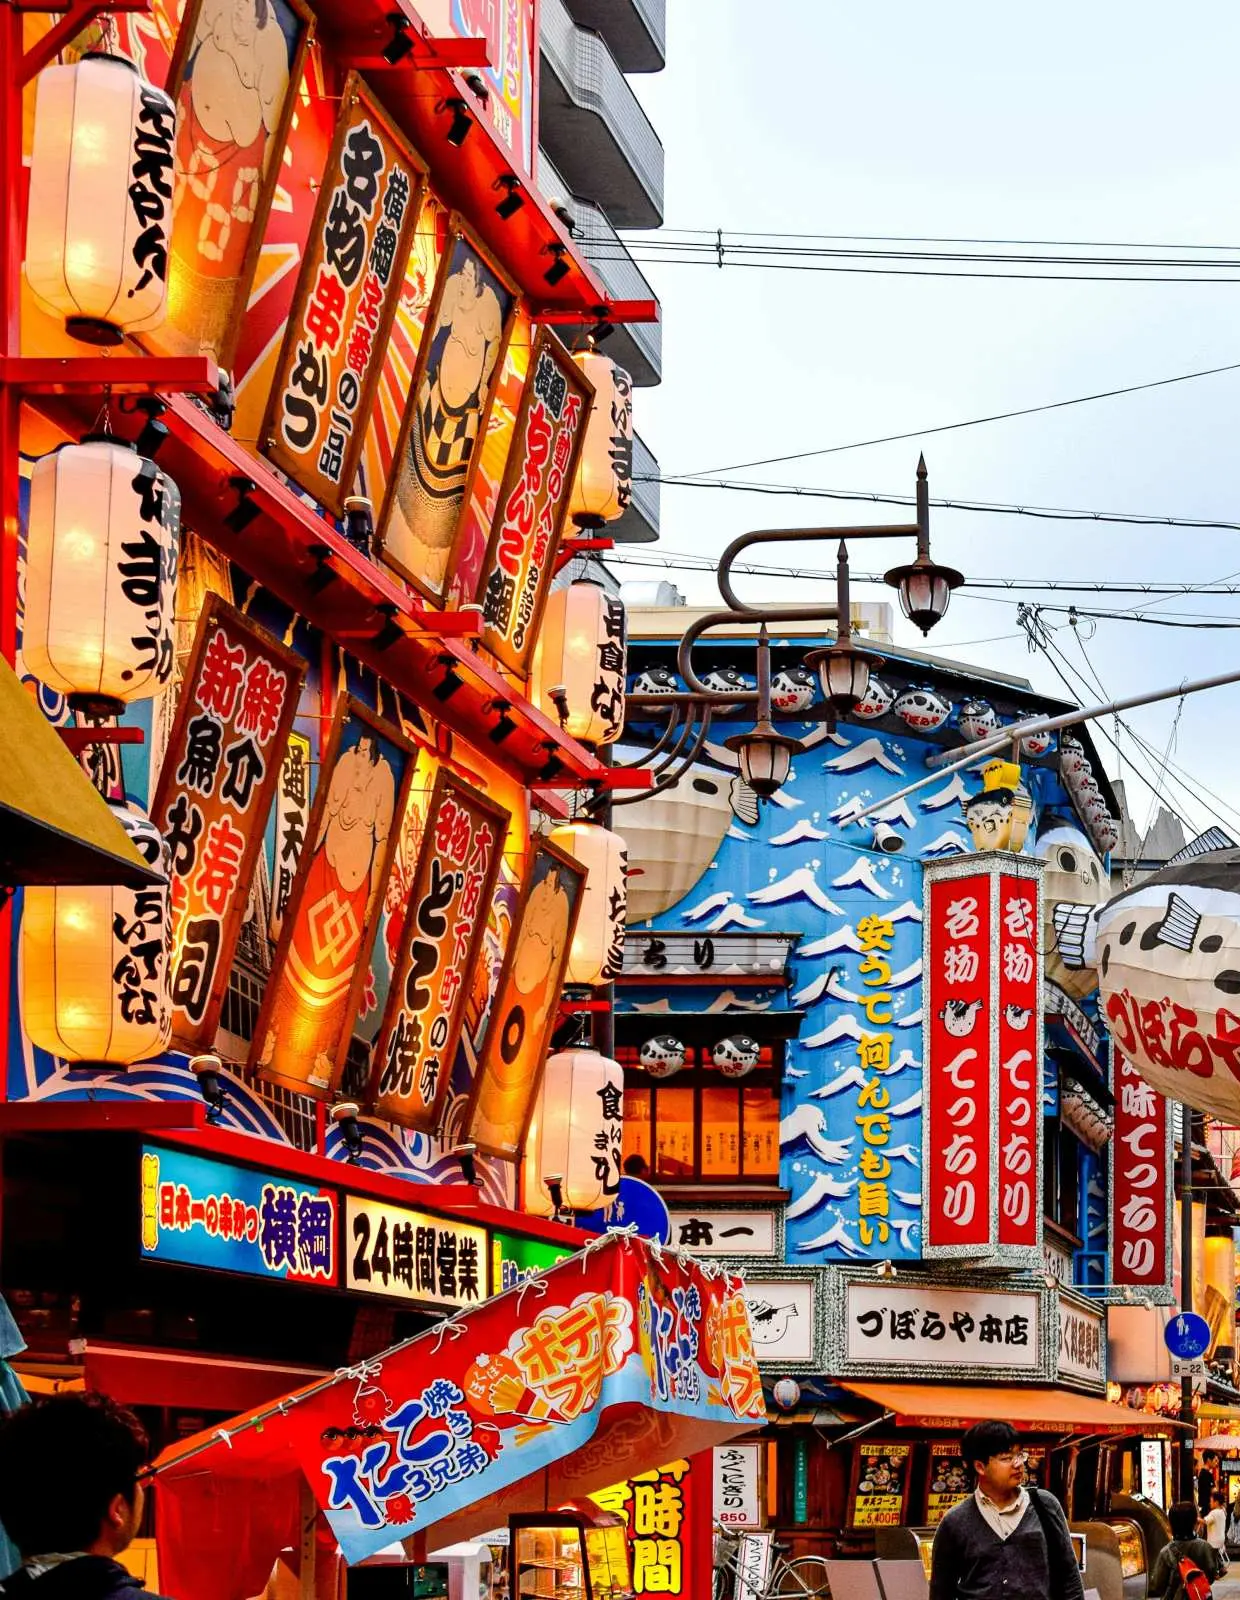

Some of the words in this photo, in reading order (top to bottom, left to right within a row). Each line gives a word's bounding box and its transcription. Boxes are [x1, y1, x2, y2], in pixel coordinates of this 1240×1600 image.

[420, 825, 493, 1106] 大阪下町の味
[943, 896, 981, 985] 名物
[856, 913, 897, 1246] 安うて何んでも旨い
[941, 1048, 980, 1227] てっちり
[1001, 1048, 1034, 1227] てっちり
[159, 1184, 259, 1244] 日本一の串かつ
[260, 1184, 333, 1279] 横綱
[1120, 1060, 1158, 1277] 味てっちり
[353, 1212, 480, 1302] 24時間営業
[856, 1308, 1030, 1347] づぼらや本店
[720, 1513, 747, 1522] 850
